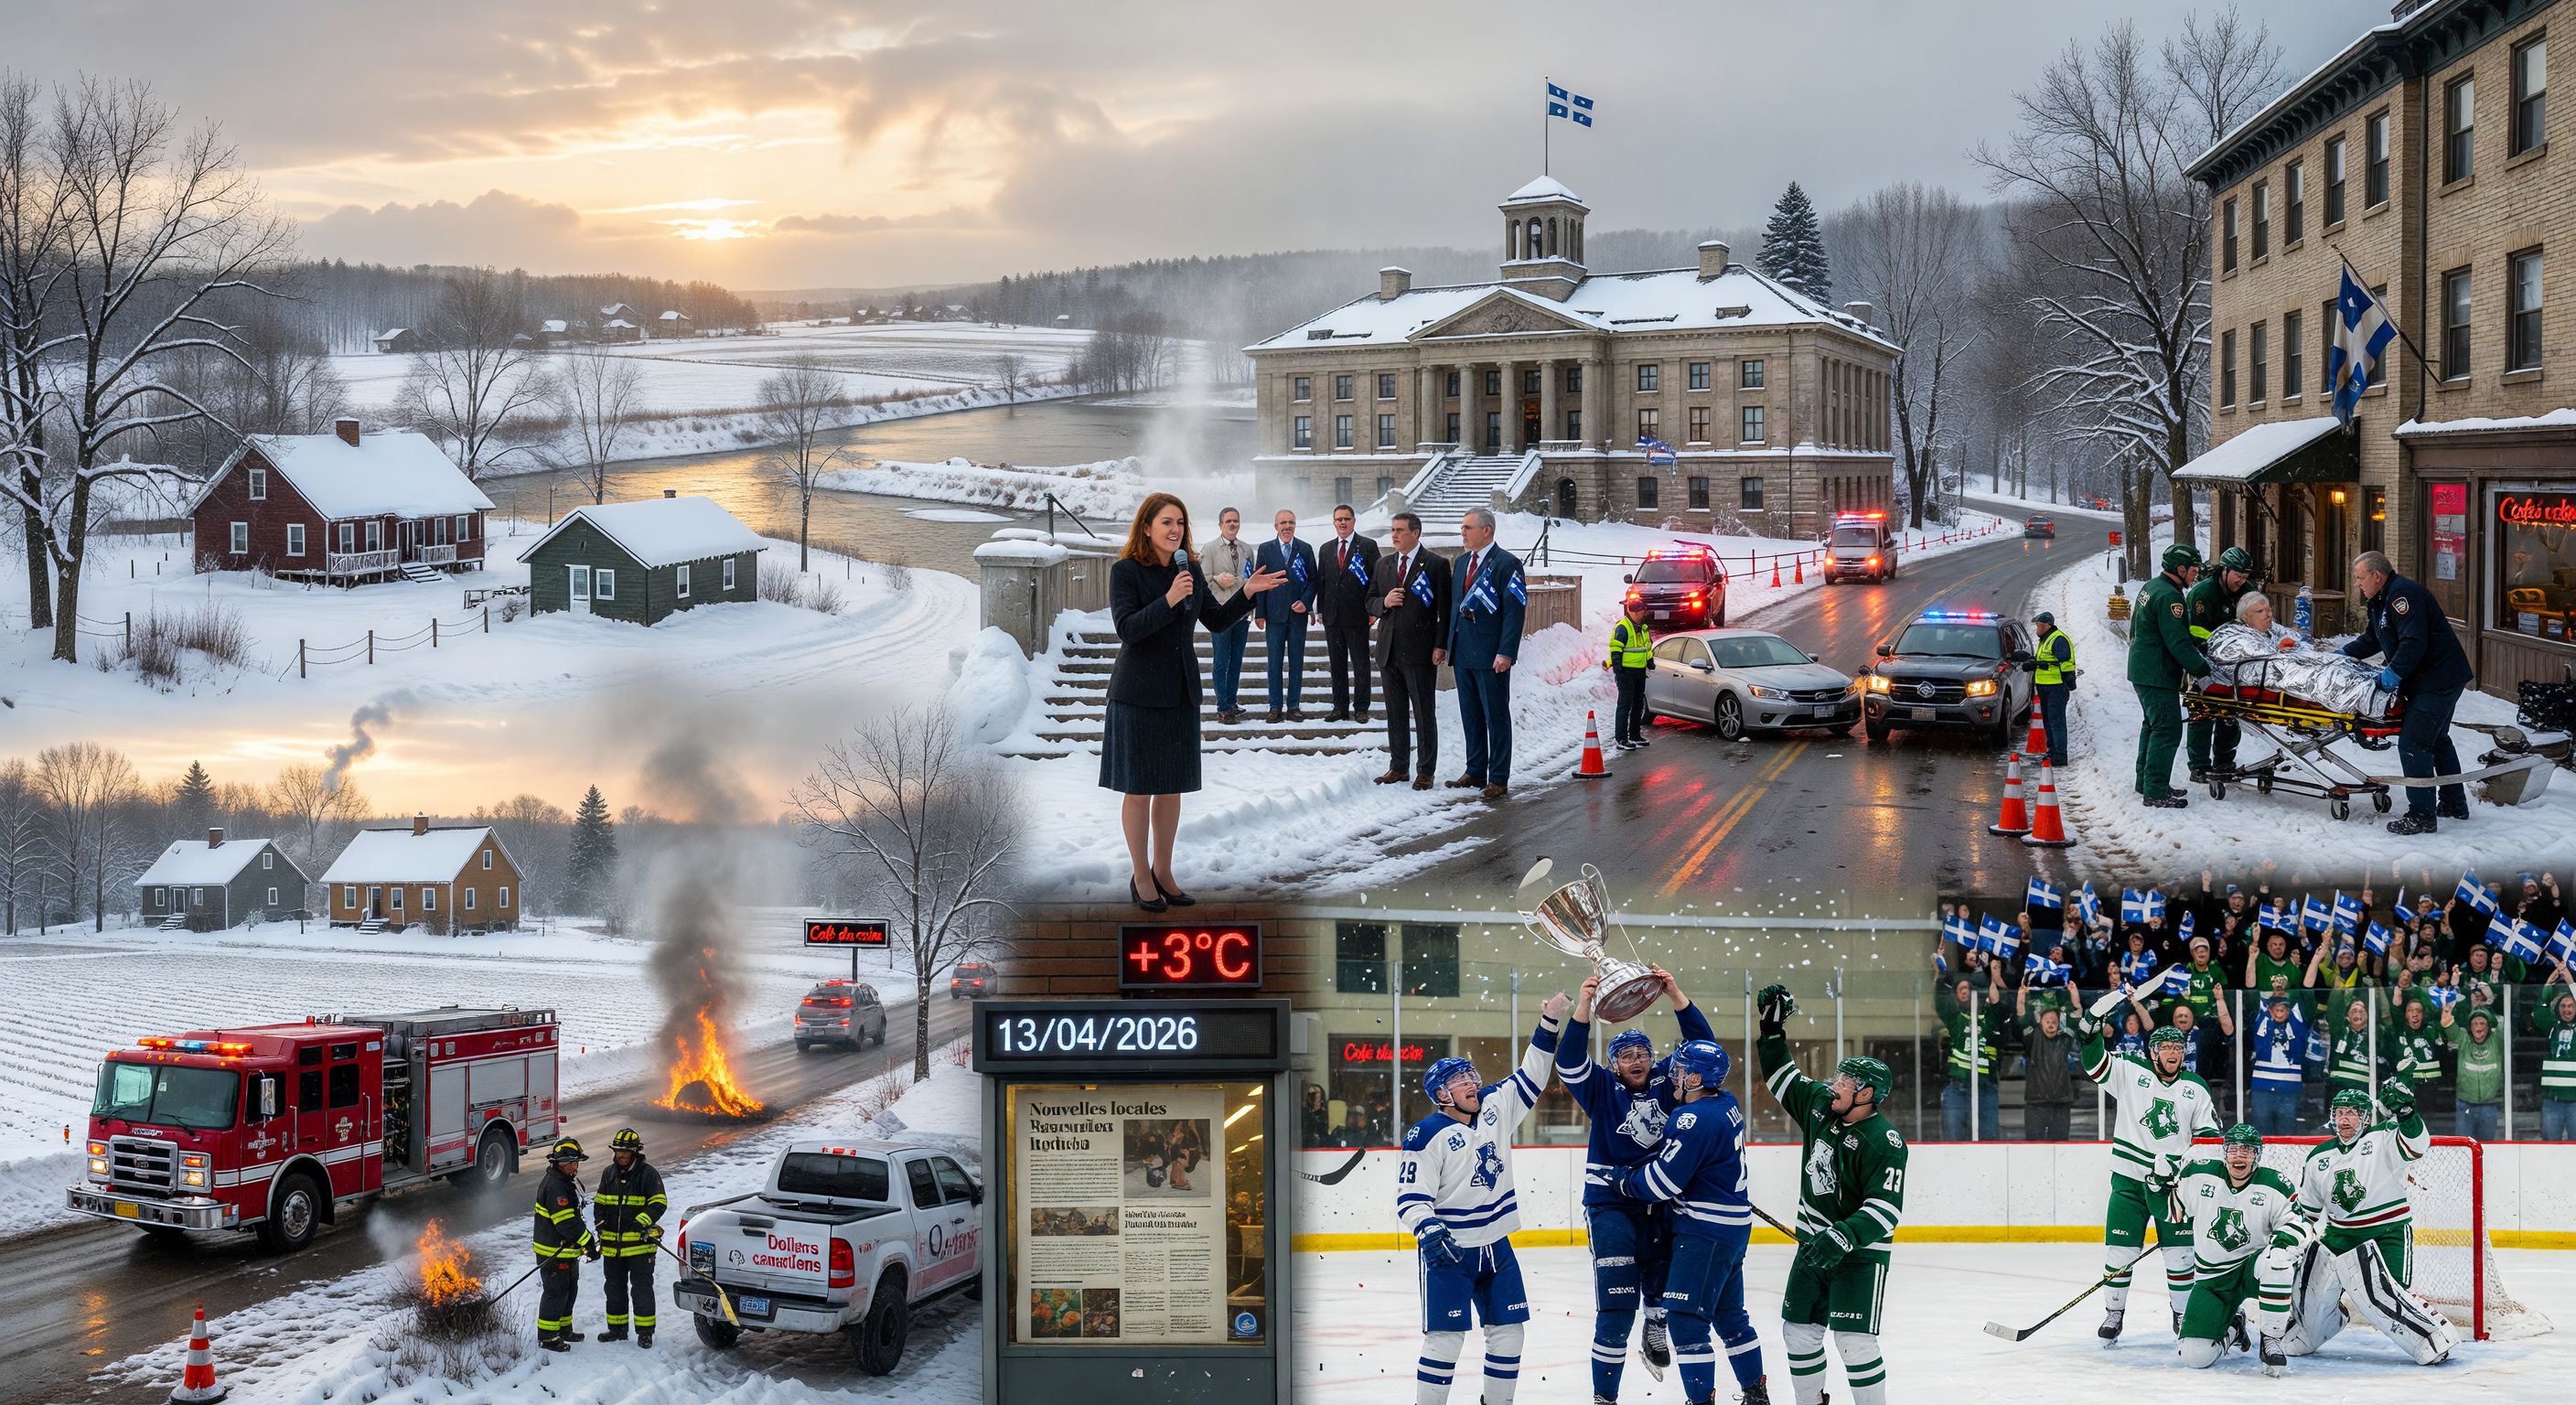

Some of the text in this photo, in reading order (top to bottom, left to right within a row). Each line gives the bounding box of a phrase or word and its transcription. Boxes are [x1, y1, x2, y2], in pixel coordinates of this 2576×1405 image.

[1130, 932, 1250, 979] +3°C
[999, 1016, 1197, 1052] 13/04/2026
[1029, 1100, 1167, 1117] Nouvelles locales
